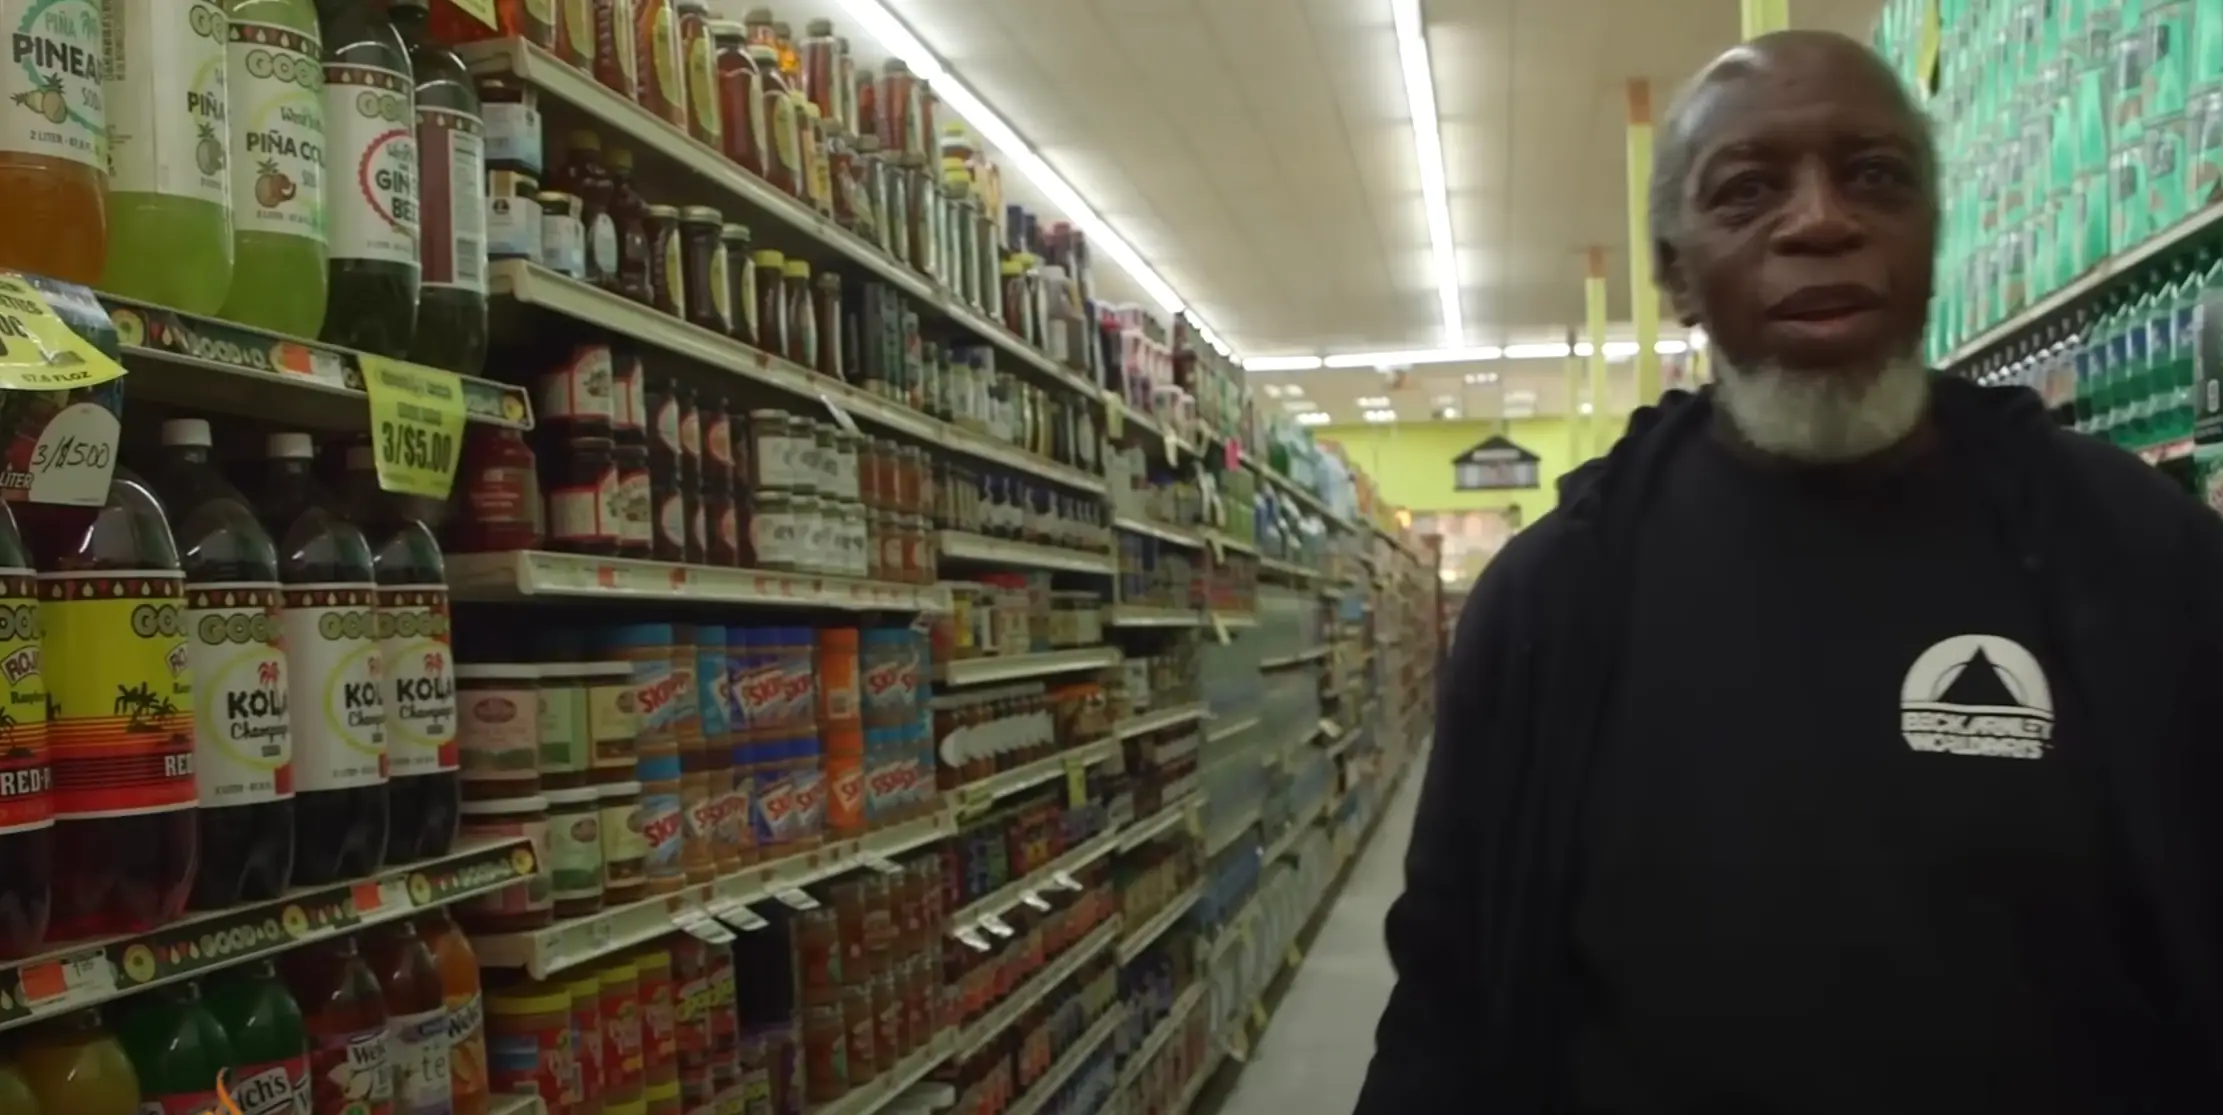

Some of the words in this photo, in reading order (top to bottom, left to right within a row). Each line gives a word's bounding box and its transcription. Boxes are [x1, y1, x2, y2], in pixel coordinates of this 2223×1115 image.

[246, 130, 298, 158] PIÑA
[382, 420, 452, 474] 3/$5.00
[0, 471, 34, 491] LITER
